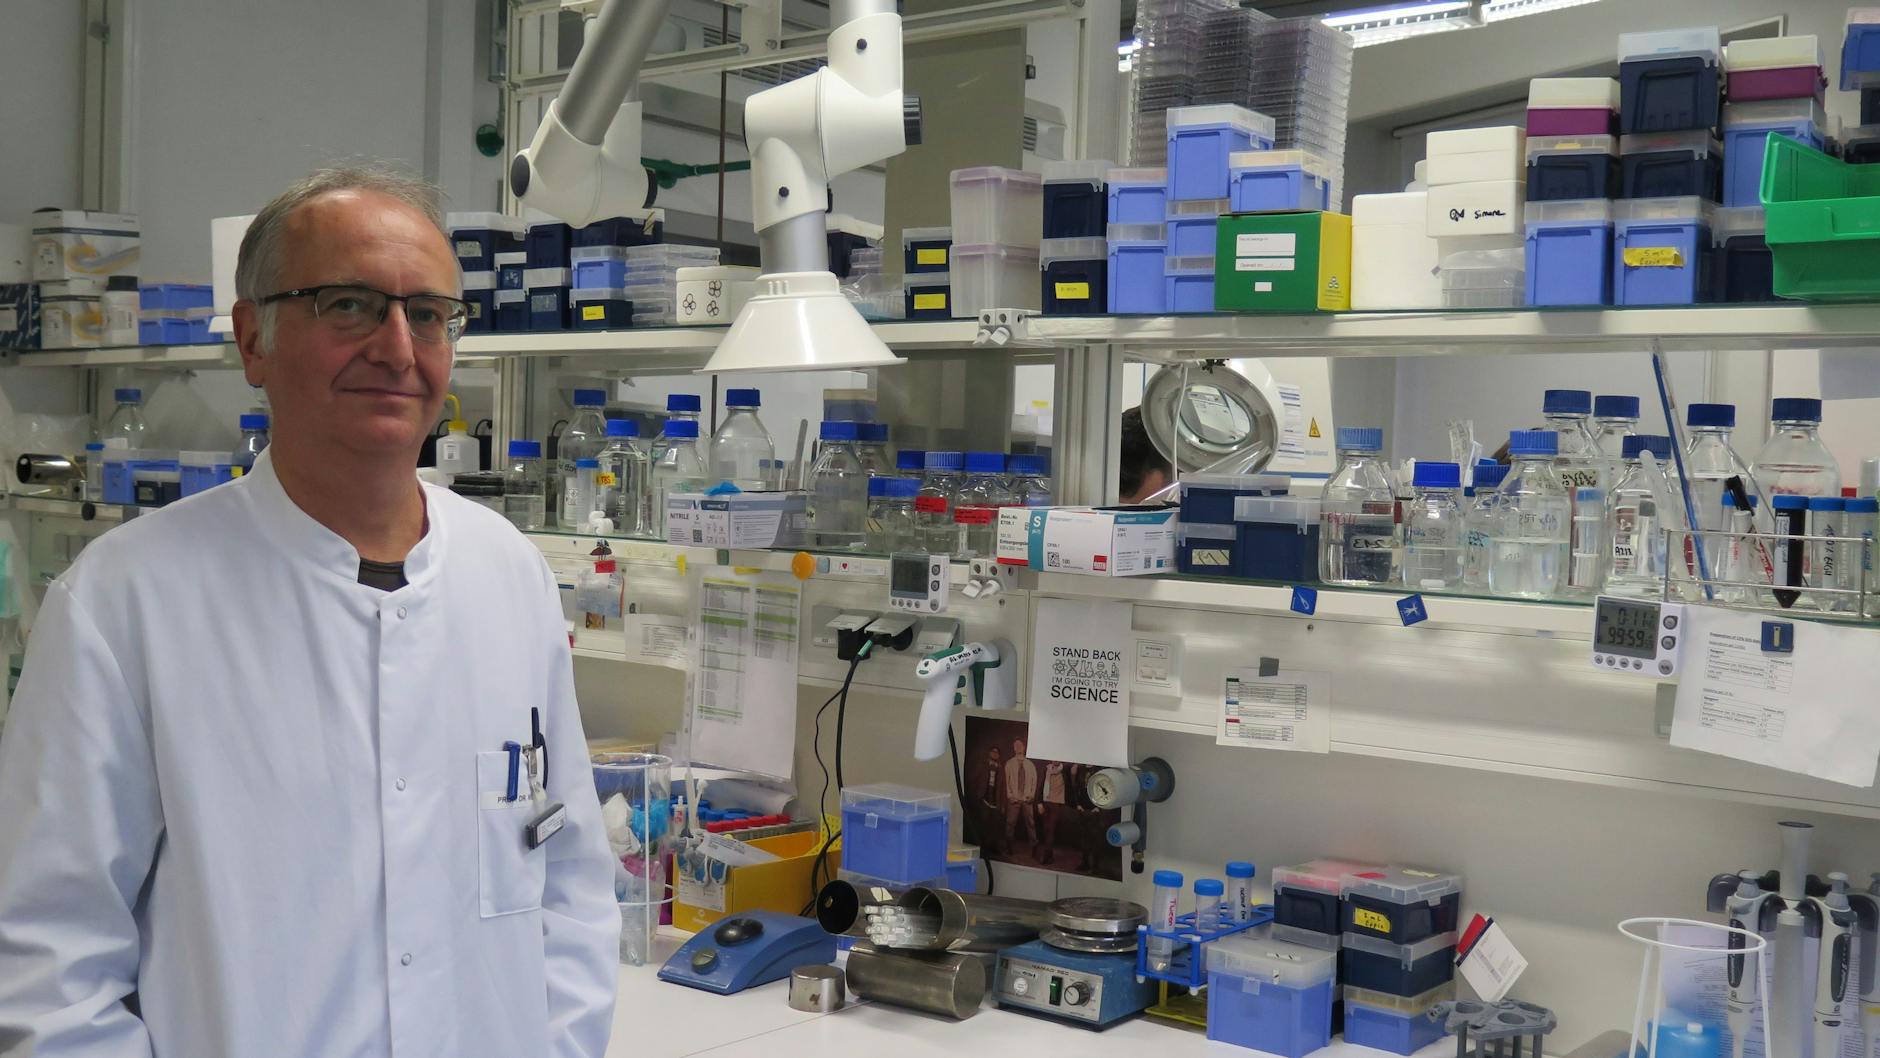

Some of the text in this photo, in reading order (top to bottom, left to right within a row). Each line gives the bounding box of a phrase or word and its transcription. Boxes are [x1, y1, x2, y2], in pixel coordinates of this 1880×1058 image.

[669, 512, 690, 520] NITRILE
[1033, 515, 1042, 528] S
[1052, 646, 1121, 661] STAND BACK
[1064, 677, 1090, 687] GOING
[1092, 679, 1103, 688] TO
[1104, 680, 1119, 689] TRY
[1050, 684, 1119, 704] SCIENCE
